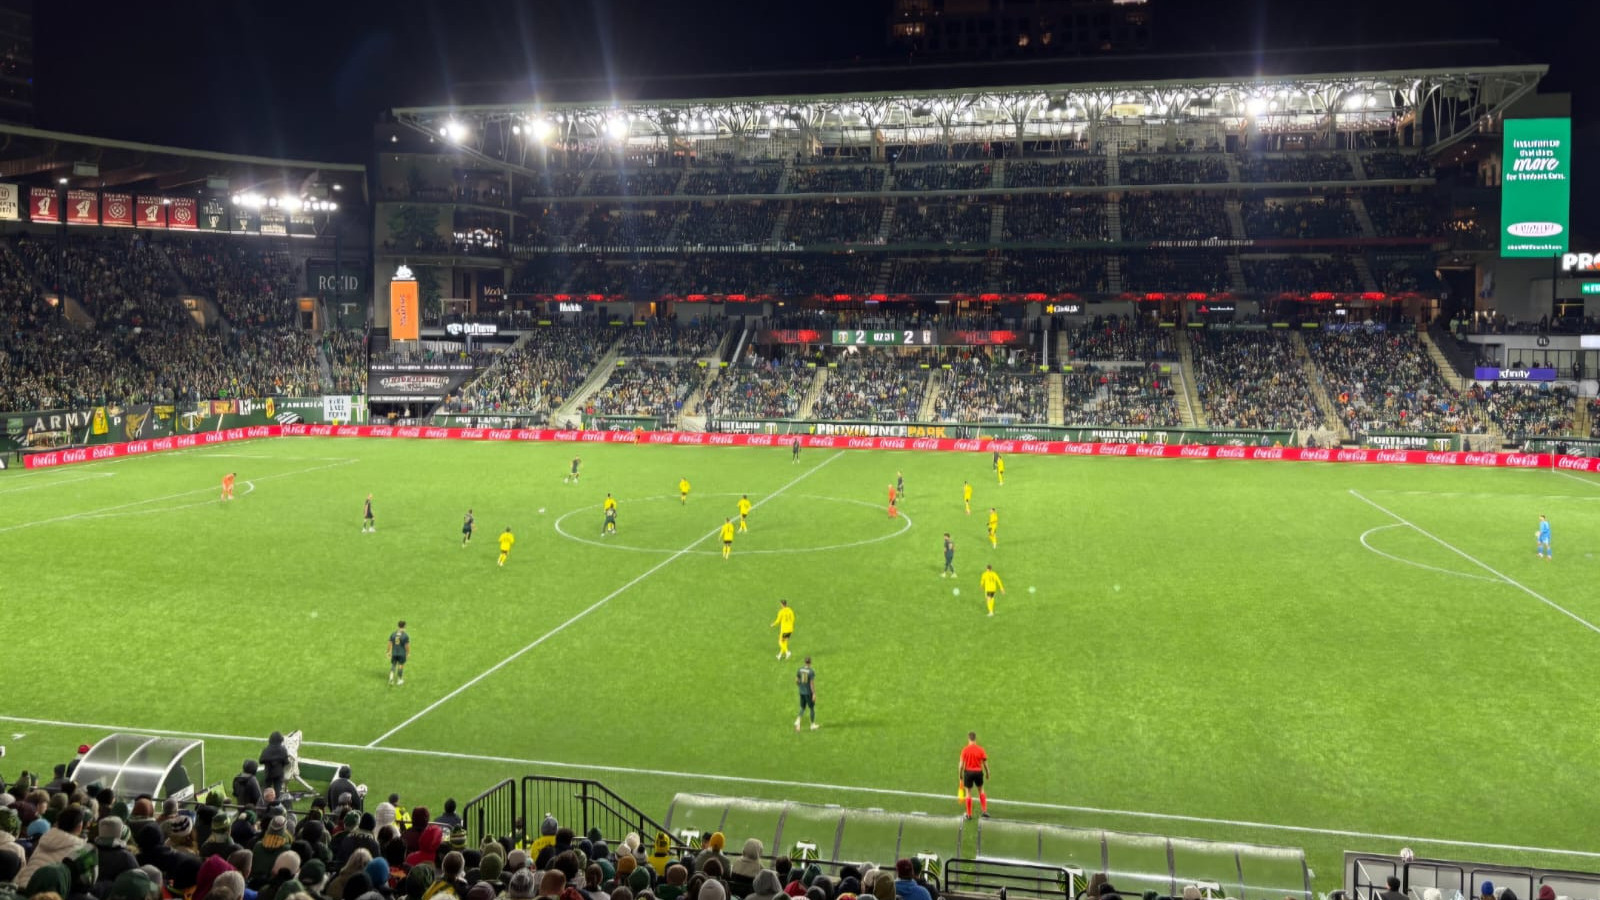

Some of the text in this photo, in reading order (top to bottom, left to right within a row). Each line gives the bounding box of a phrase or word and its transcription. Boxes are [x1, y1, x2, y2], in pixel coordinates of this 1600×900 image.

[1513, 158, 1559, 171] more
[319, 275, 358, 290] RCID
[855, 330, 866, 344] 2
[904, 330, 914, 344] 2
[1499, 369, 1530, 378] xfinity
[34, 410, 92, 432] ARMY
[817, 424, 945, 438] PROVIDENCE PARK
